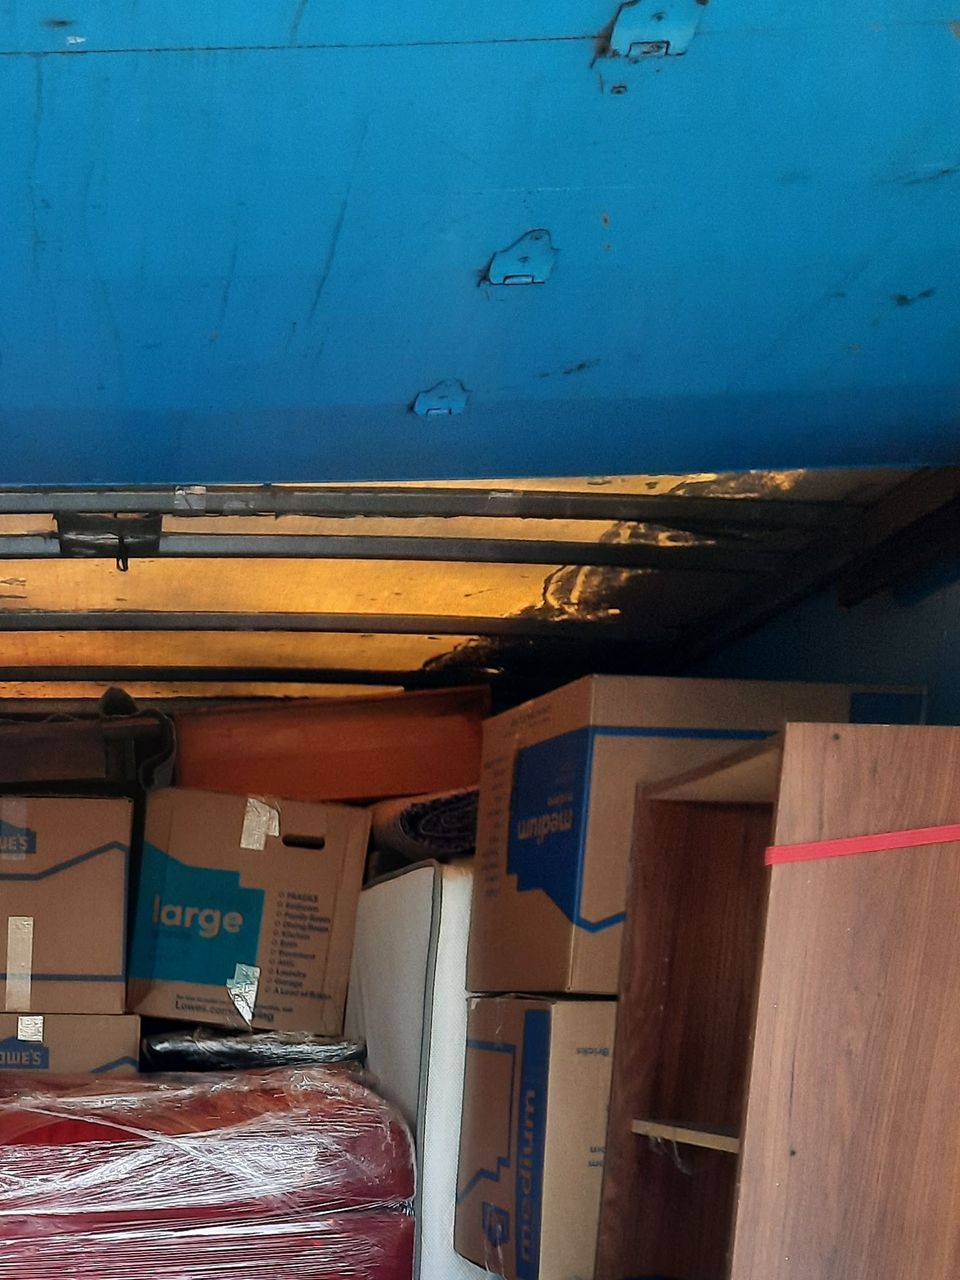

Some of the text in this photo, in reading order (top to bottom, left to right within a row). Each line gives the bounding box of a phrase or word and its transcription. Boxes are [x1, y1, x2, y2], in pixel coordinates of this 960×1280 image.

[517, 808, 573, 845] medium
[153, 895, 243, 939] large
[519, 1089, 536, 1262] medium
